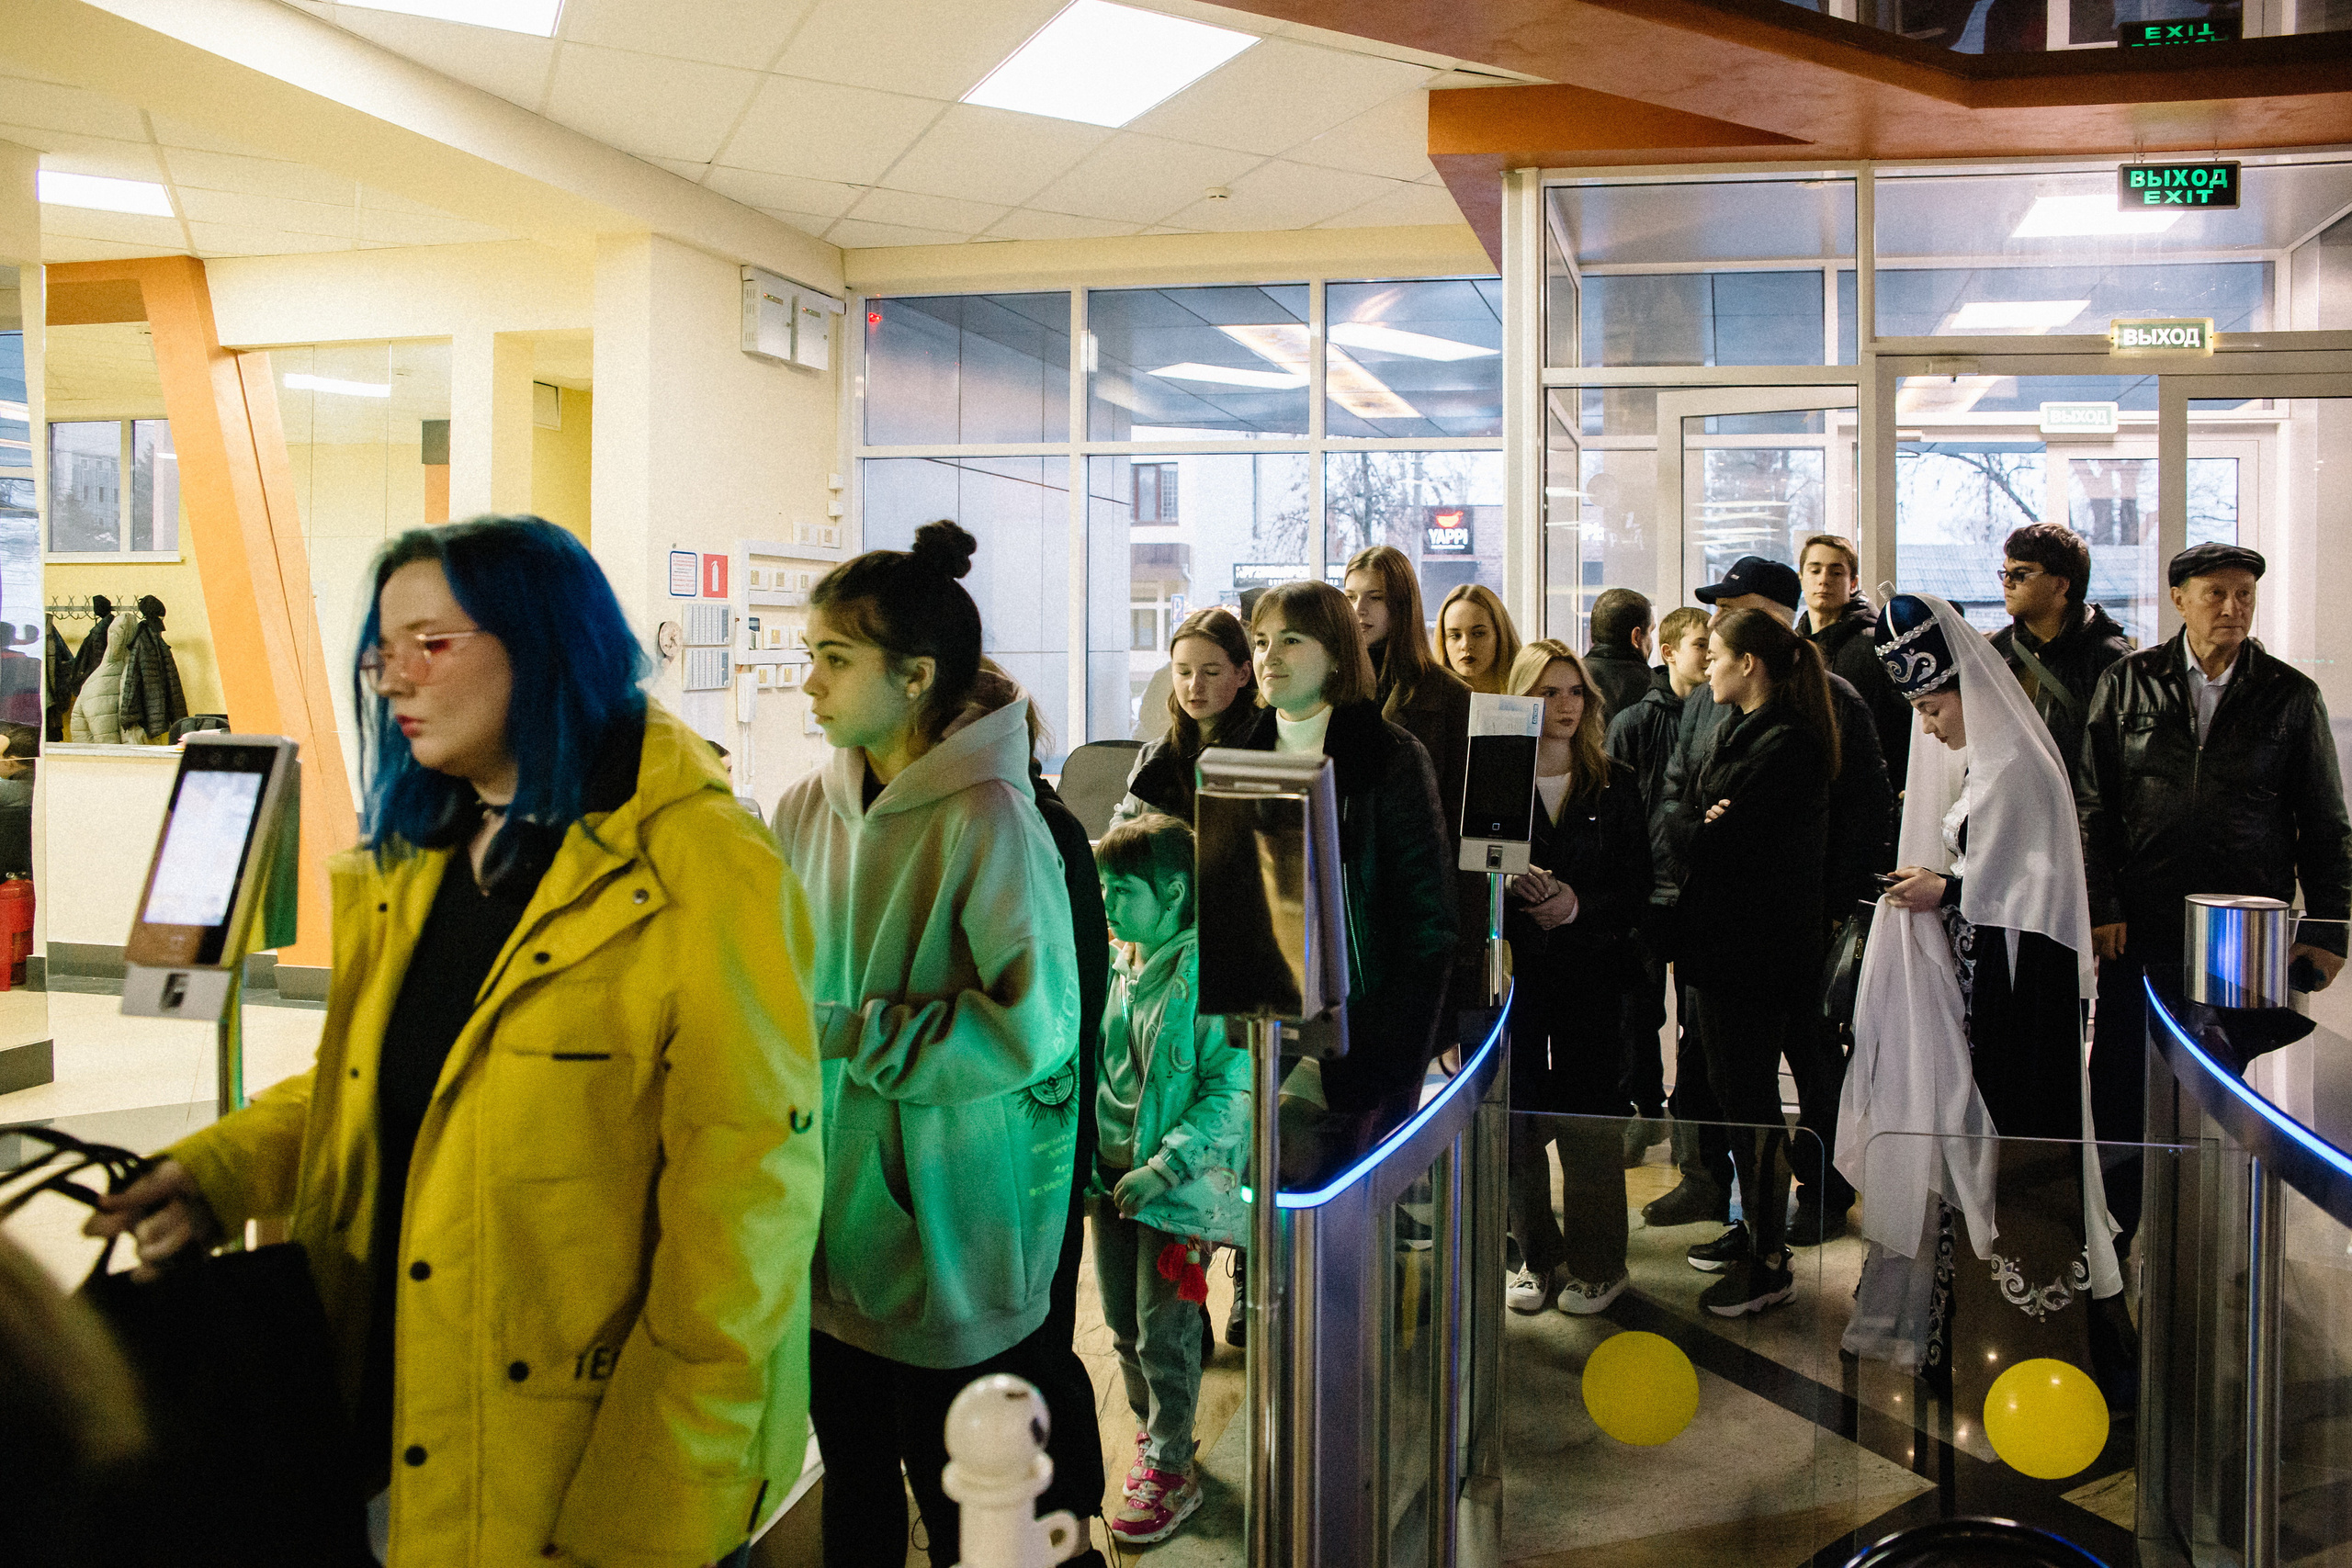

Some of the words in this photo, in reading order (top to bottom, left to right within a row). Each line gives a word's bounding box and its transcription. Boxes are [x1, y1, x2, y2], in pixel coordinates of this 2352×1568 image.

[2130, 169, 2228, 188] ВЫХОД
[2143, 189, 2213, 205] EXIT
[2123, 328, 2200, 347] ВЫХОД
[2050, 410, 2108, 424] ВЫХОД
